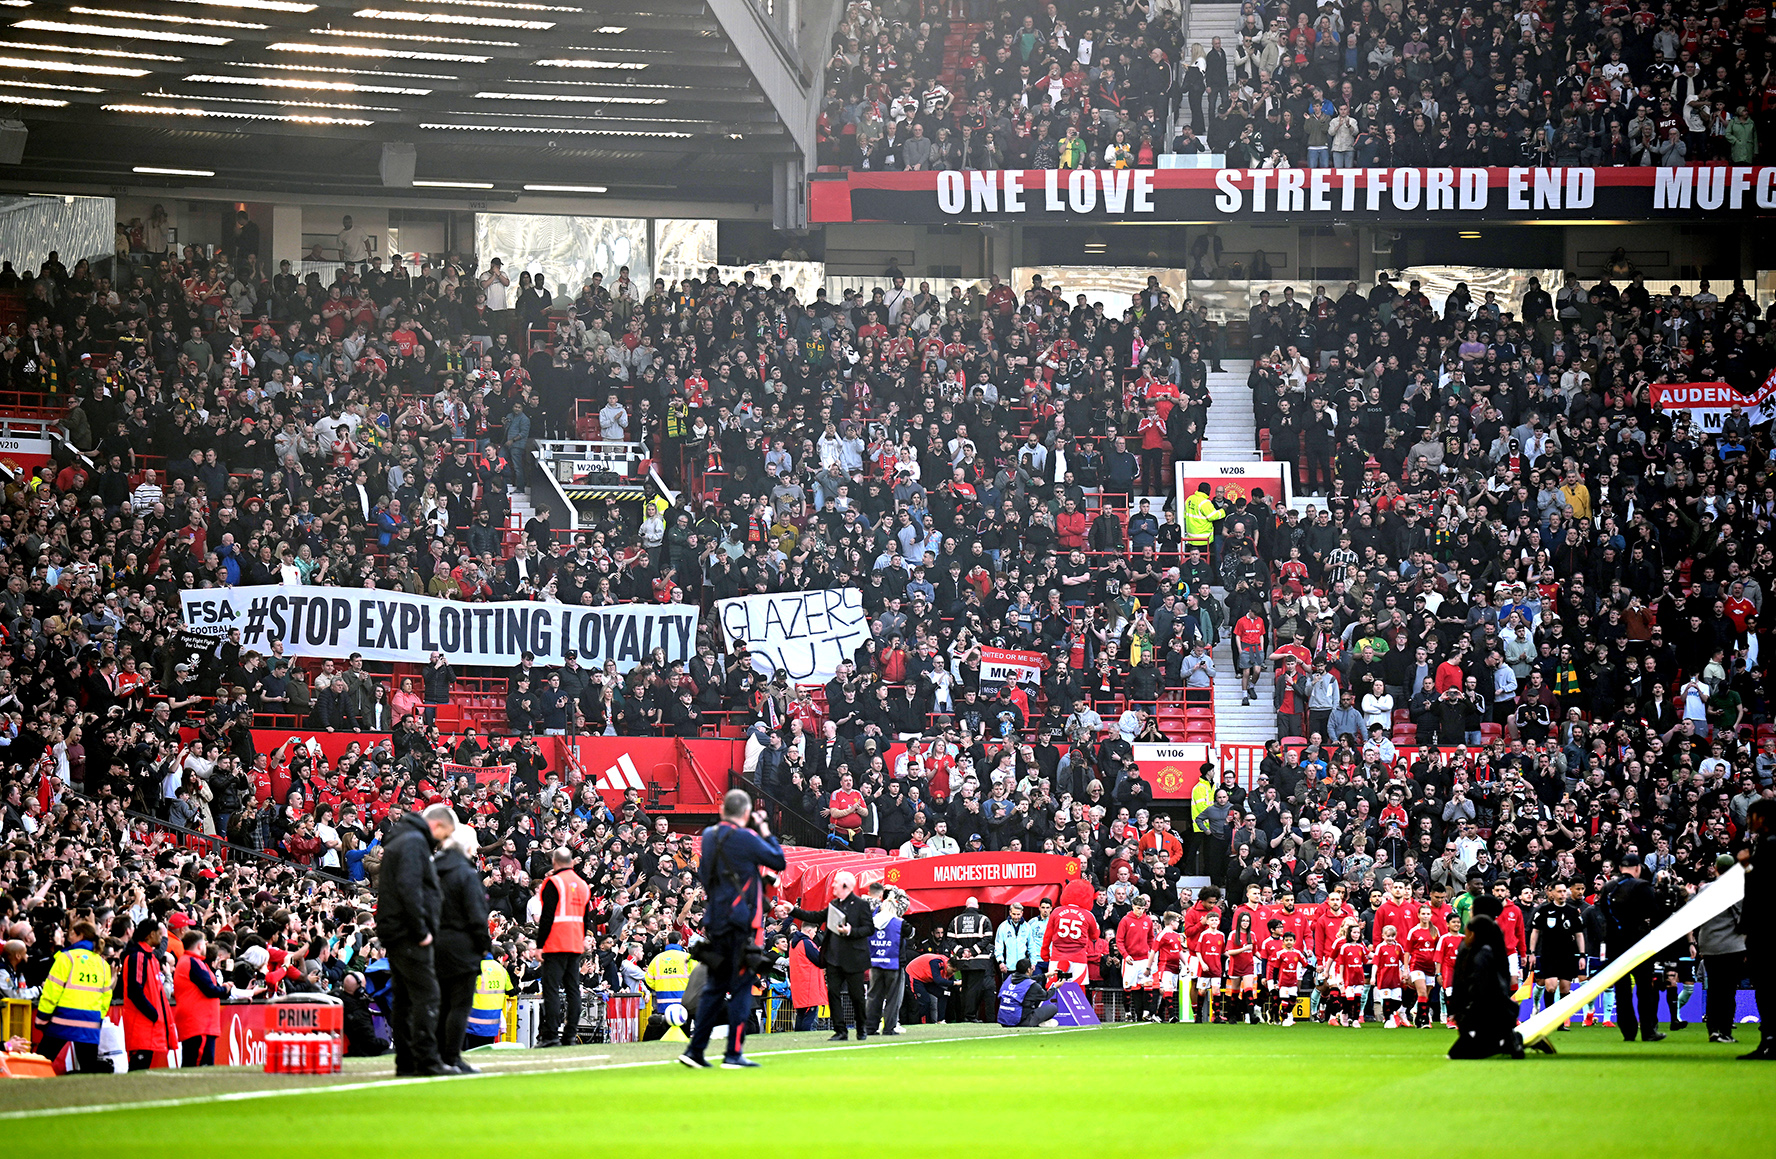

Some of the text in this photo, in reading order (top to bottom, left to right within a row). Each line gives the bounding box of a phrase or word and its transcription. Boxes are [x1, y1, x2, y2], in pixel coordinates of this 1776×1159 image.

[1659, 119, 1677, 129] MUFC
[937, 168, 1155, 215] ONE LOVE
[1214, 167, 1596, 213] STRETFORD END
[1653, 166, 1776, 210] MUFC
[577, 463, 602, 471] W209
[187, 600, 236, 624] FSA
[723, 588, 866, 642] GLAZERS
[243, 595, 693, 662] #STOP EXPLOITING LOYALTY
[982, 651, 1004, 659] UNITED
[1157, 750, 1184, 758] W106
[934, 863, 1036, 882] MANCHESTER UNITED
[1058, 918, 1083, 940] 55
[79, 972, 98, 984] 213
[488, 981, 500, 989] 233
[279, 1009, 318, 1027] PRIME
[1297, 1005, 1302, 1016] 6
